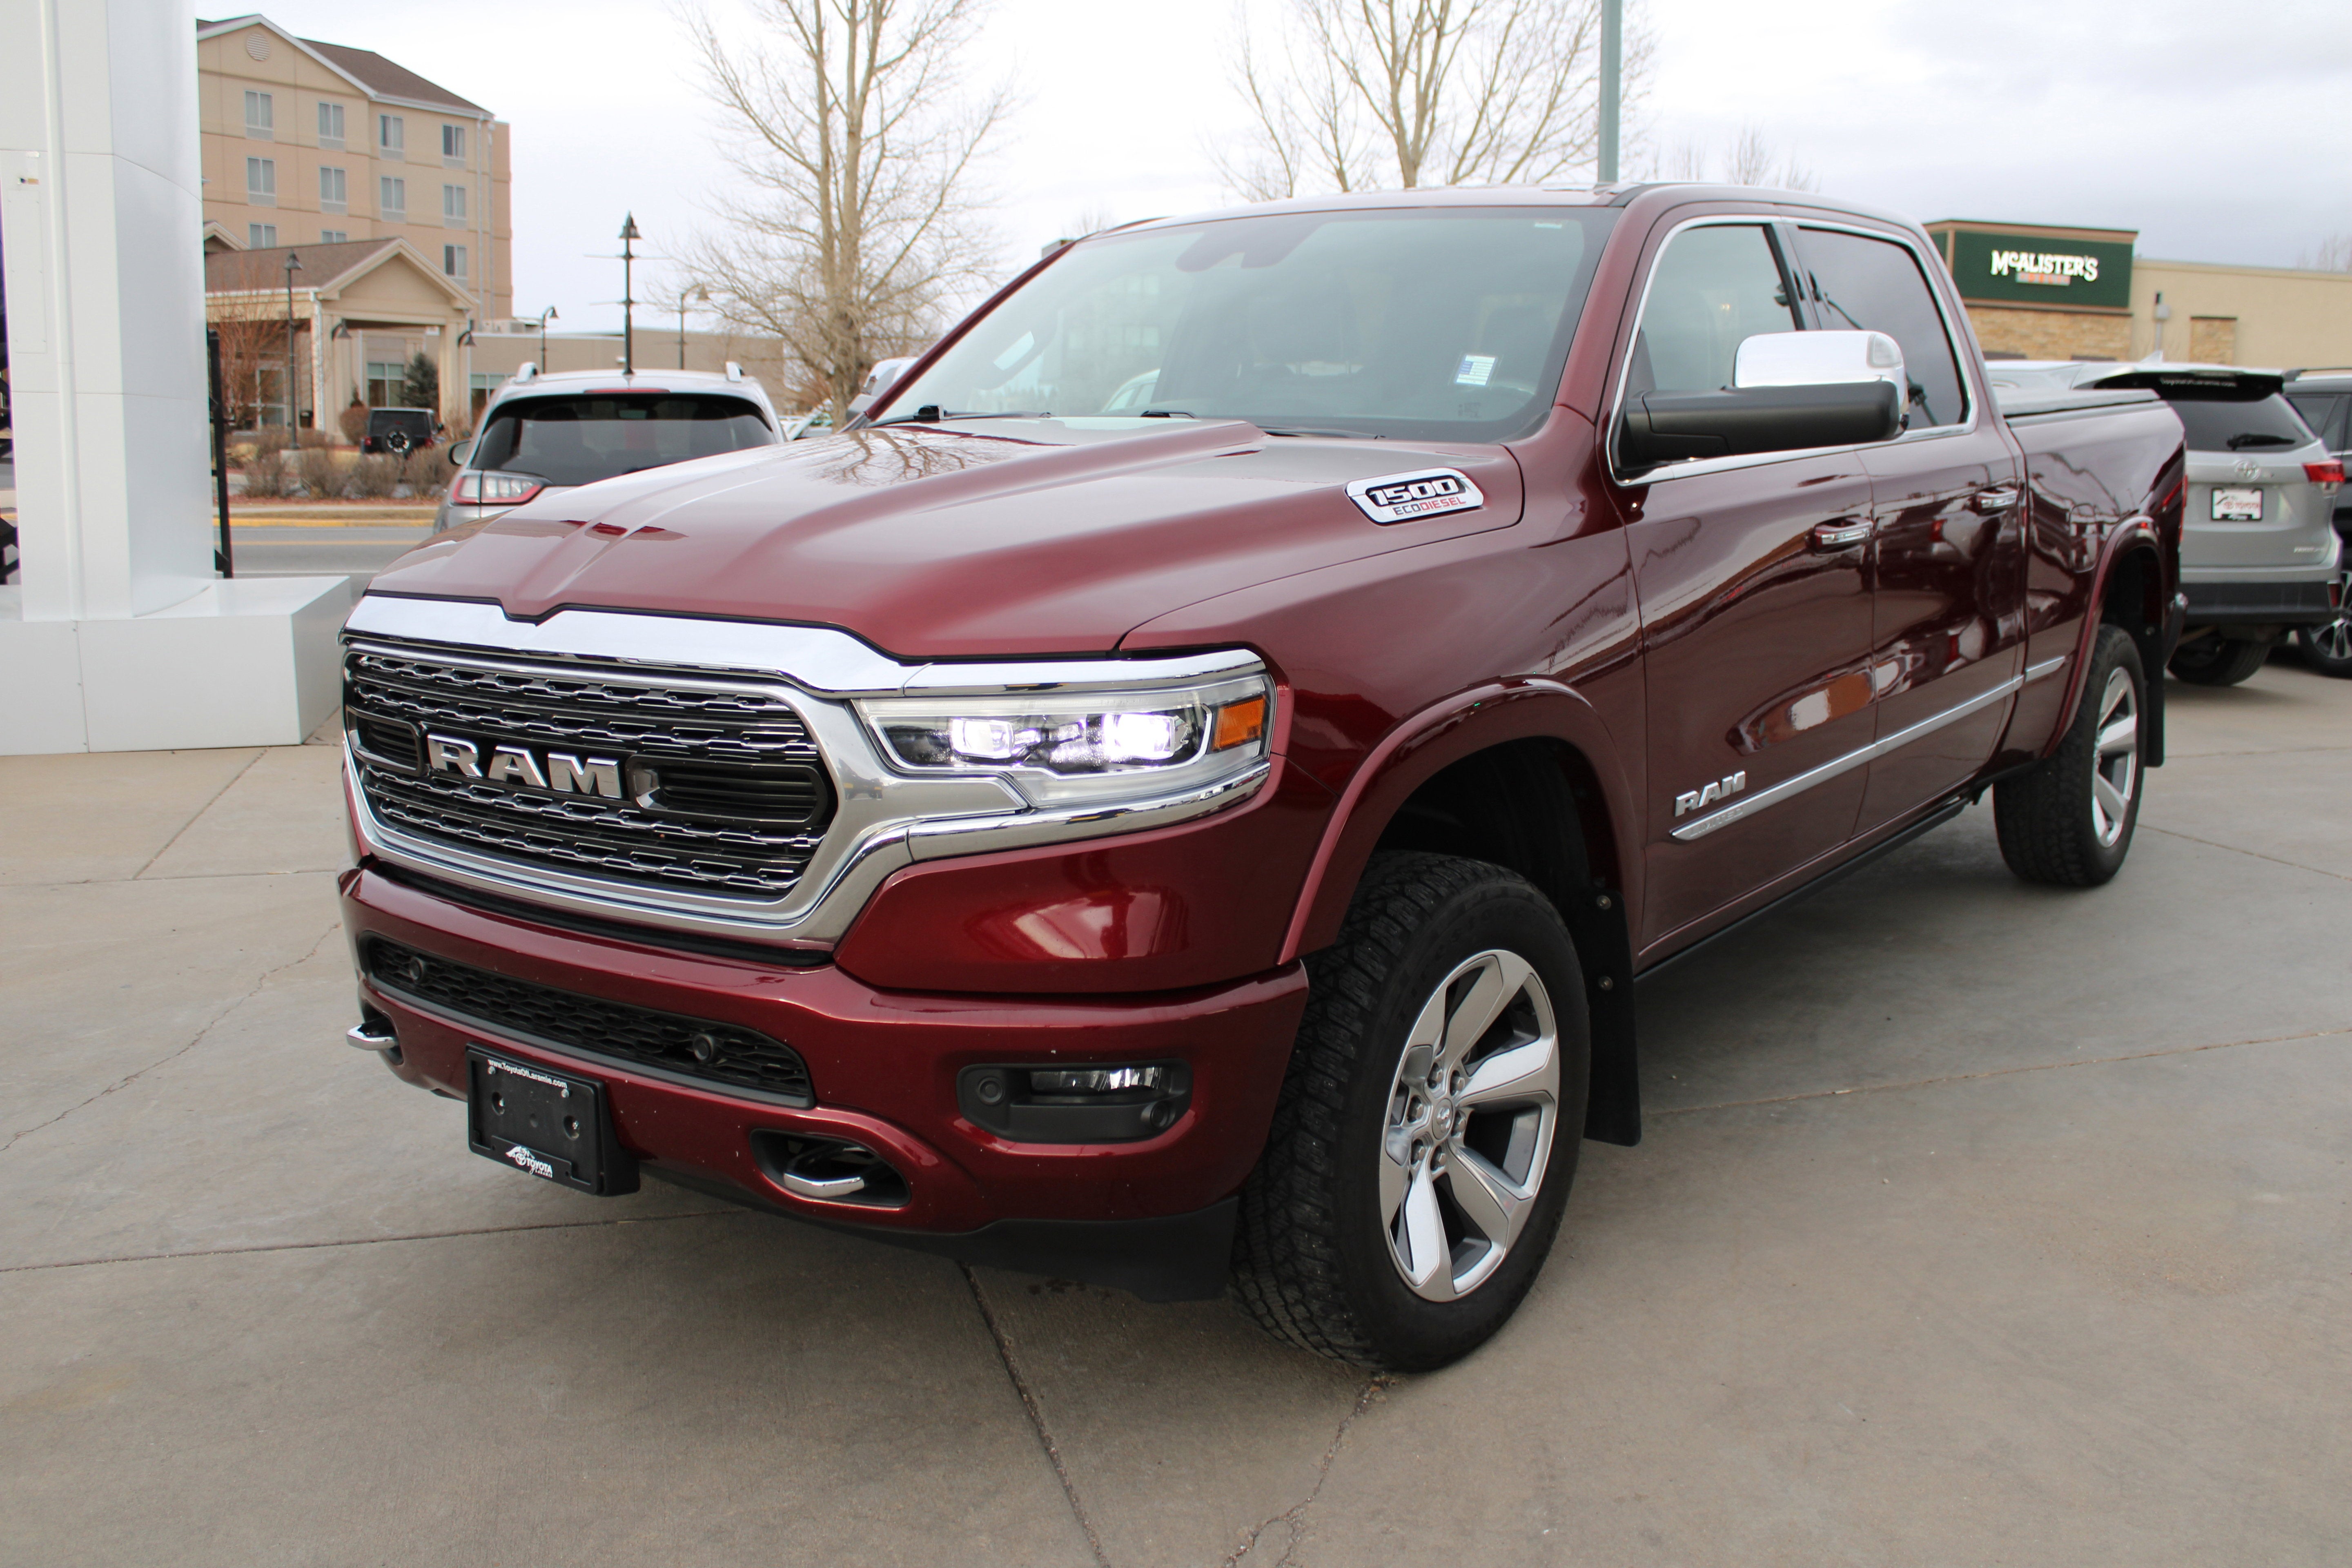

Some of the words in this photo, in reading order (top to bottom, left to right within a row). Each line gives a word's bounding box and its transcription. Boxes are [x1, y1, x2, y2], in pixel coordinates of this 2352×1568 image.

[1369, 478, 1459, 506] 1500
[1393, 497, 1466, 516] ECODIESEL
[428, 734, 622, 798] RAM
[1675, 771, 1746, 817] RAM
[488, 1059, 567, 1088] www.ToyotaOfLaramie.com
[526, 1158, 552, 1174] TOYOTA
